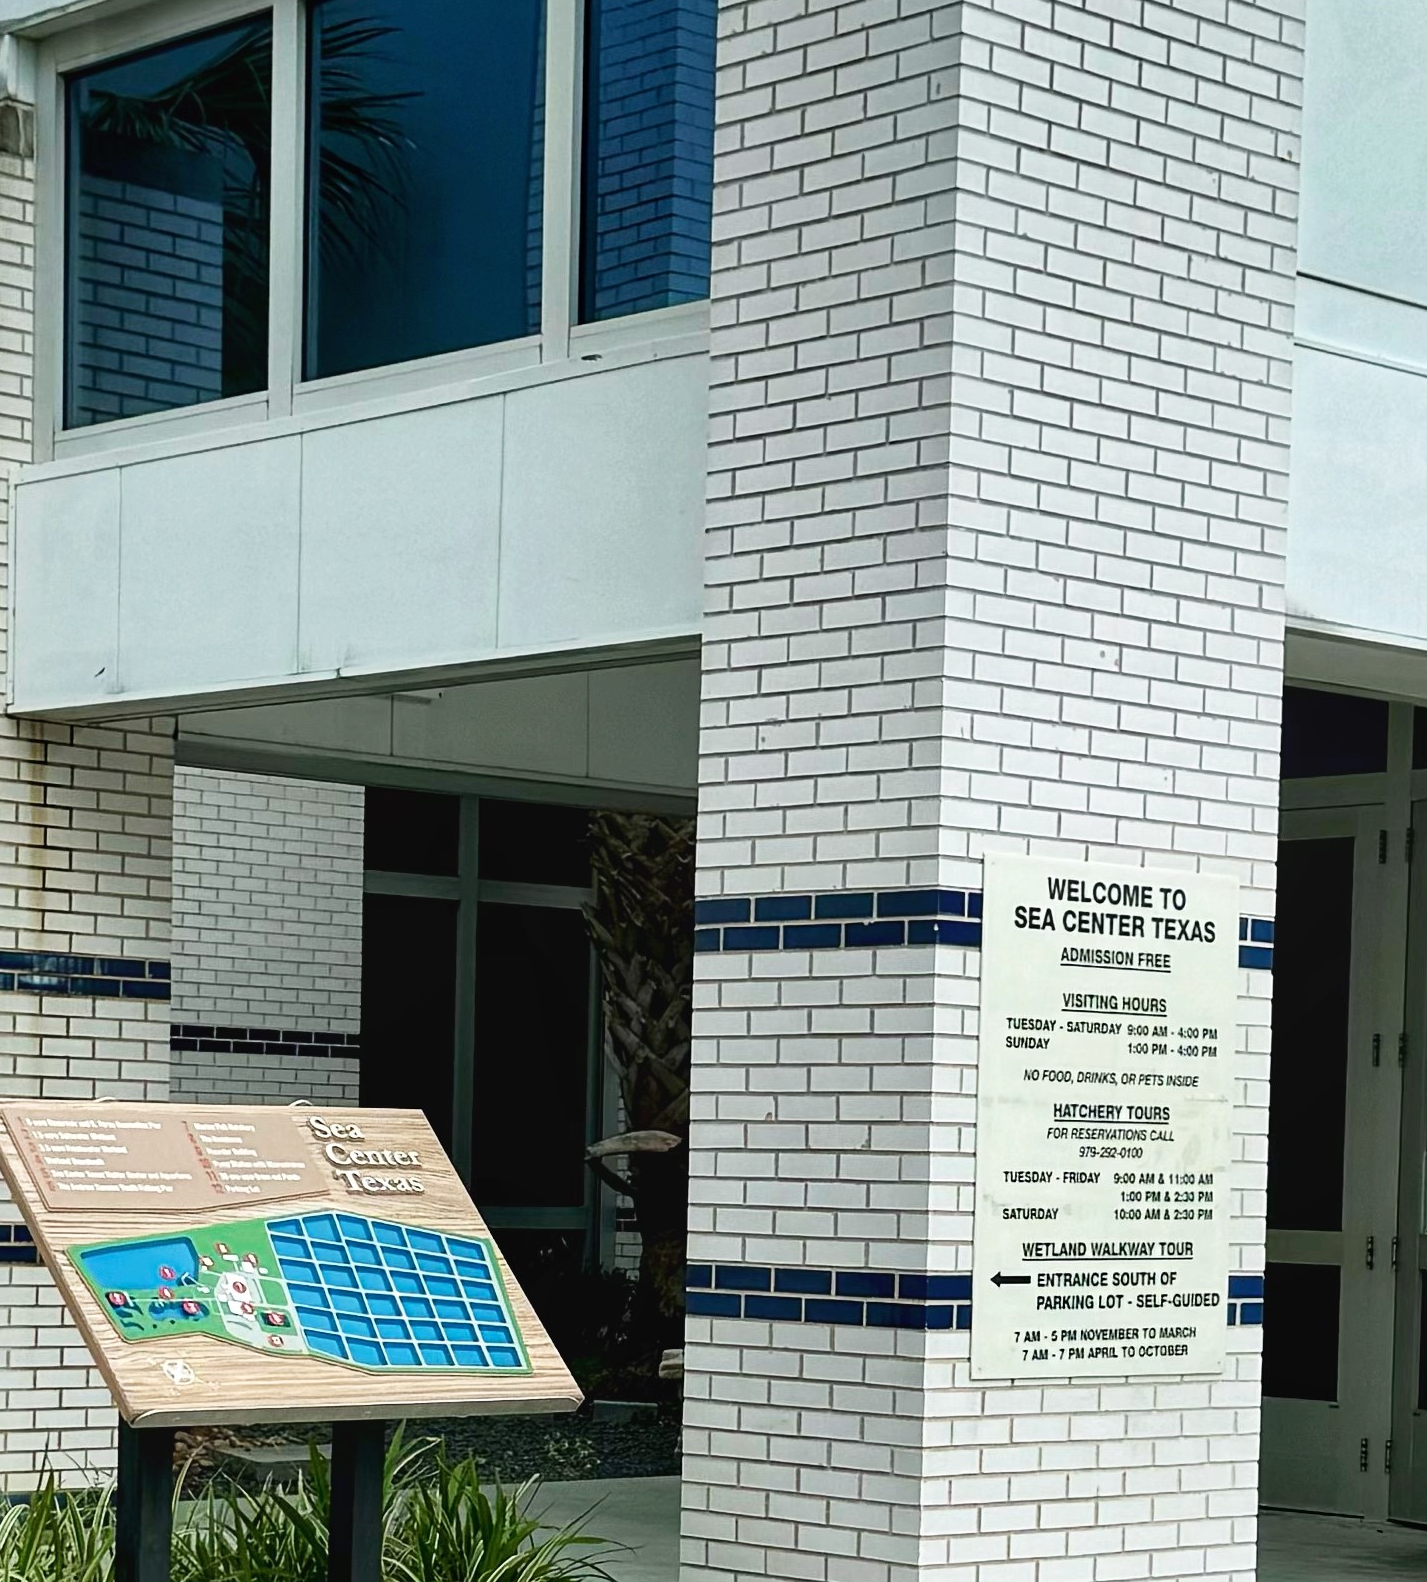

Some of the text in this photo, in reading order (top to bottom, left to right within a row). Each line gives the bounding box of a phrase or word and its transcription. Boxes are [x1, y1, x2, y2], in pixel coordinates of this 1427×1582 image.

[1047, 877, 1186, 910] WELCOME TO
[1014, 905, 1215, 943] SEA CENTER TEXAS
[1061, 947, 1171, 969] ADMISSION FREE
[1063, 993, 1167, 1013] VISITING HOURS
[1007, 1017, 1056, 1032] TUESDAY
[1067, 1021, 1121, 1035] SATURDAY
[1127, 1025, 1149, 1037] 9:00
[1152, 1026, 1167, 1037] AM
[1177, 1027, 1199, 1039] 4:00
[1201, 1028, 1217, 1040] PM
[1005, 1036, 1049, 1049] SUNDAY
[1127, 1043, 1149, 1055] 1:00
[1152, 1043, 1167, 1055] PM
[1177, 1045, 1199, 1057] 4:00
[1201, 1046, 1217, 1057] PM
[1024, 1069, 1199, 1087] NO FOOD, DRINKS, OR PETS INSIDE
[1053, 1103, 1169, 1121] HATCHERY TOURS
[309, 1115, 365, 1140] Sea
[1047, 1127, 1175, 1141] FOR RESERVATIONS CALL
[324, 1143, 421, 1166] Center
[335, 1168, 425, 1192] Texas
[1003, 1171, 1053, 1183] TUESDAY
[1063, 1171, 1101, 1183] FRIDAY
[1113, 1173, 1135, 1184] 9:00
[1139, 1173, 1155, 1184] AM
[1158, 1173, 1165, 1184] &
[1169, 1173, 1195, 1185] 11:00
[1198, 1173, 1213, 1185] AM
[1121, 1191, 1213, 1202] 1:00 PM & 2:30 PM
[1003, 1207, 1213, 1220] SATURDAY 10:00 AM & 2:30 PM
[1023, 1242, 1193, 1257] WETLAND WALKWAY TOUR
[1037, 1272, 1177, 1287] ENTRANCE SOUTH OF
[1037, 1295, 1094, 1310] PARKING
[1099, 1295, 1123, 1309] LOT
[1137, 1293, 1220, 1308] SELF-GUIDED
[1015, 1332, 1021, 1343] 7
[1024, 1331, 1041, 1343] AM
[1061, 1330, 1077, 1341] PM
[1081, 1328, 1139, 1341] NOVEMBER
[1143, 1327, 1156, 1339] TO
[1159, 1327, 1196, 1339] MARCH
[1023, 1350, 1029, 1361] 7
[1032, 1349, 1049, 1360] AM
[1059, 1349, 1065, 1359] 7
[1069, 1348, 1085, 1359] PM
[1088, 1347, 1118, 1359] APRIL
[1121, 1347, 1135, 1357] TO
[1139, 1345, 1188, 1357] OCTOBER
